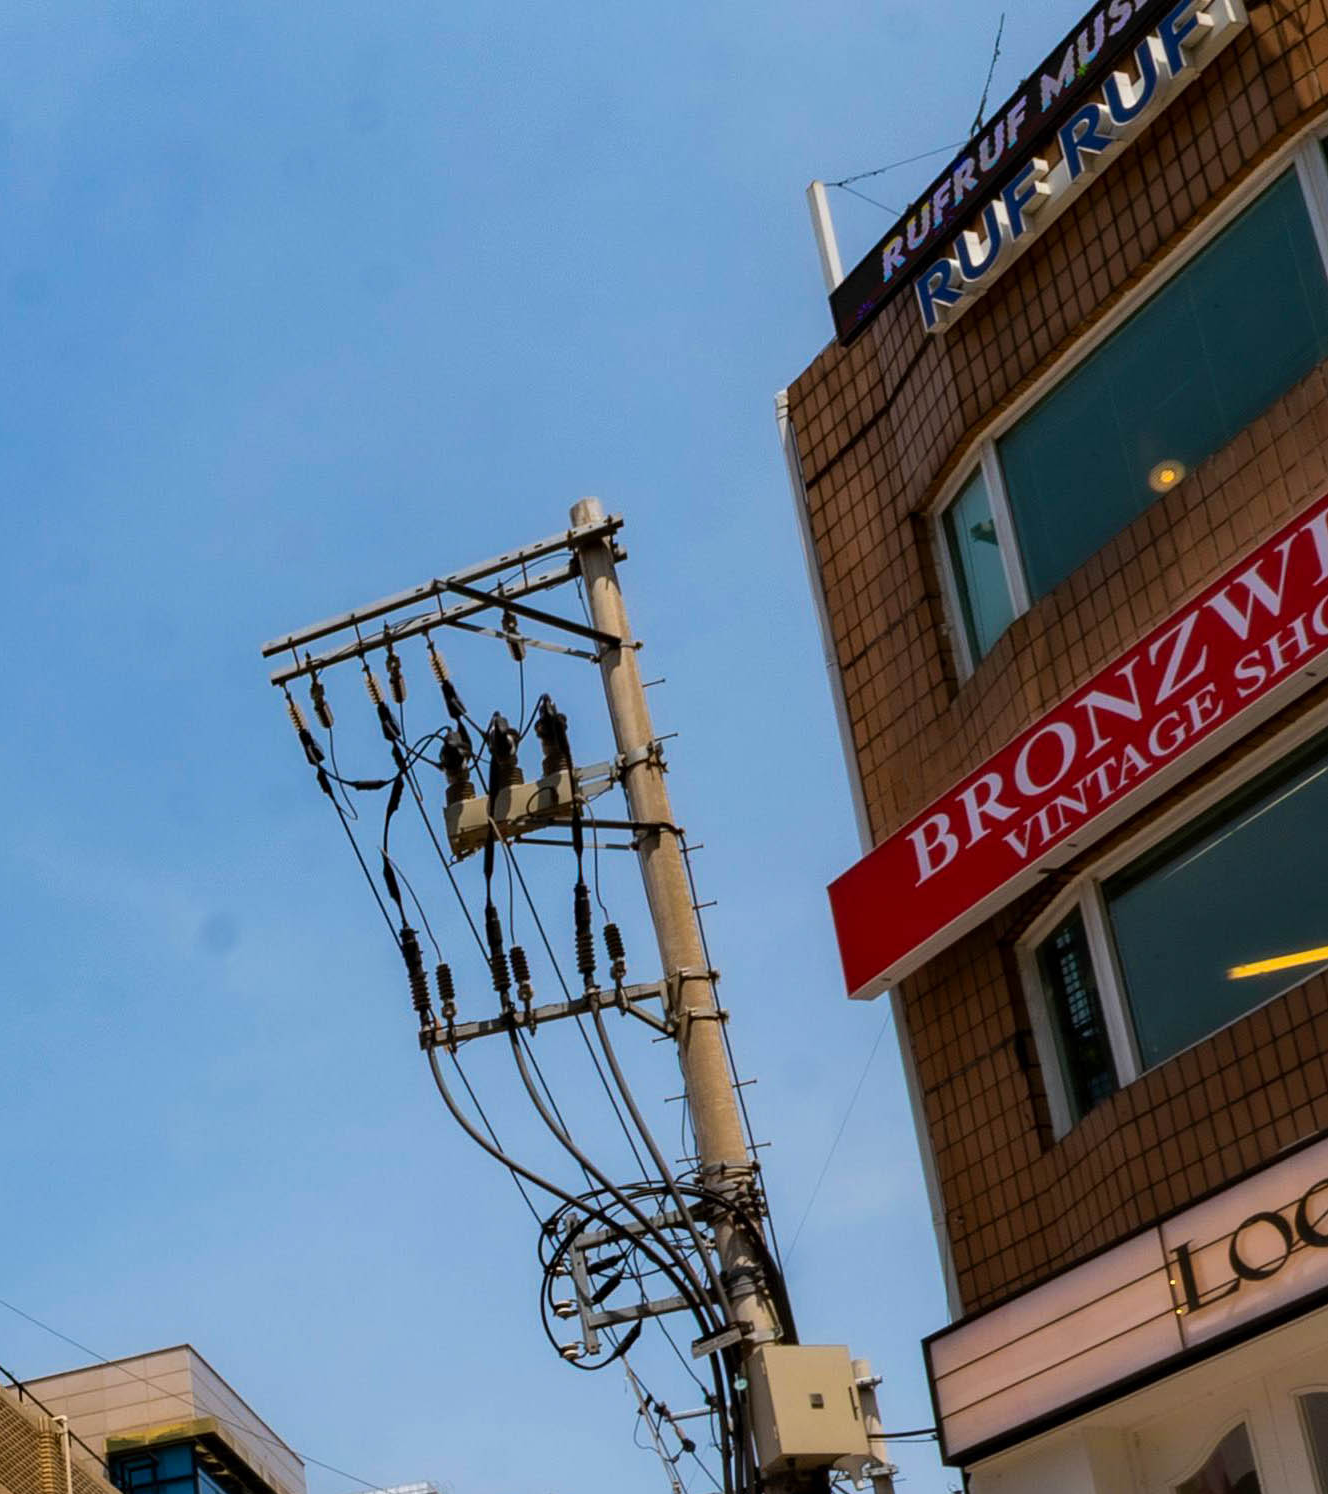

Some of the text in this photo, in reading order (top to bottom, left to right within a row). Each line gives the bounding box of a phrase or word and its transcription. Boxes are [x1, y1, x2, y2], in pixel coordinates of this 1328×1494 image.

[882, 0, 1144, 283] RUFRUF MUS
[914, 0, 1211, 333] RUF RUF
[1002, 682, 1223, 860] VINTAGE
